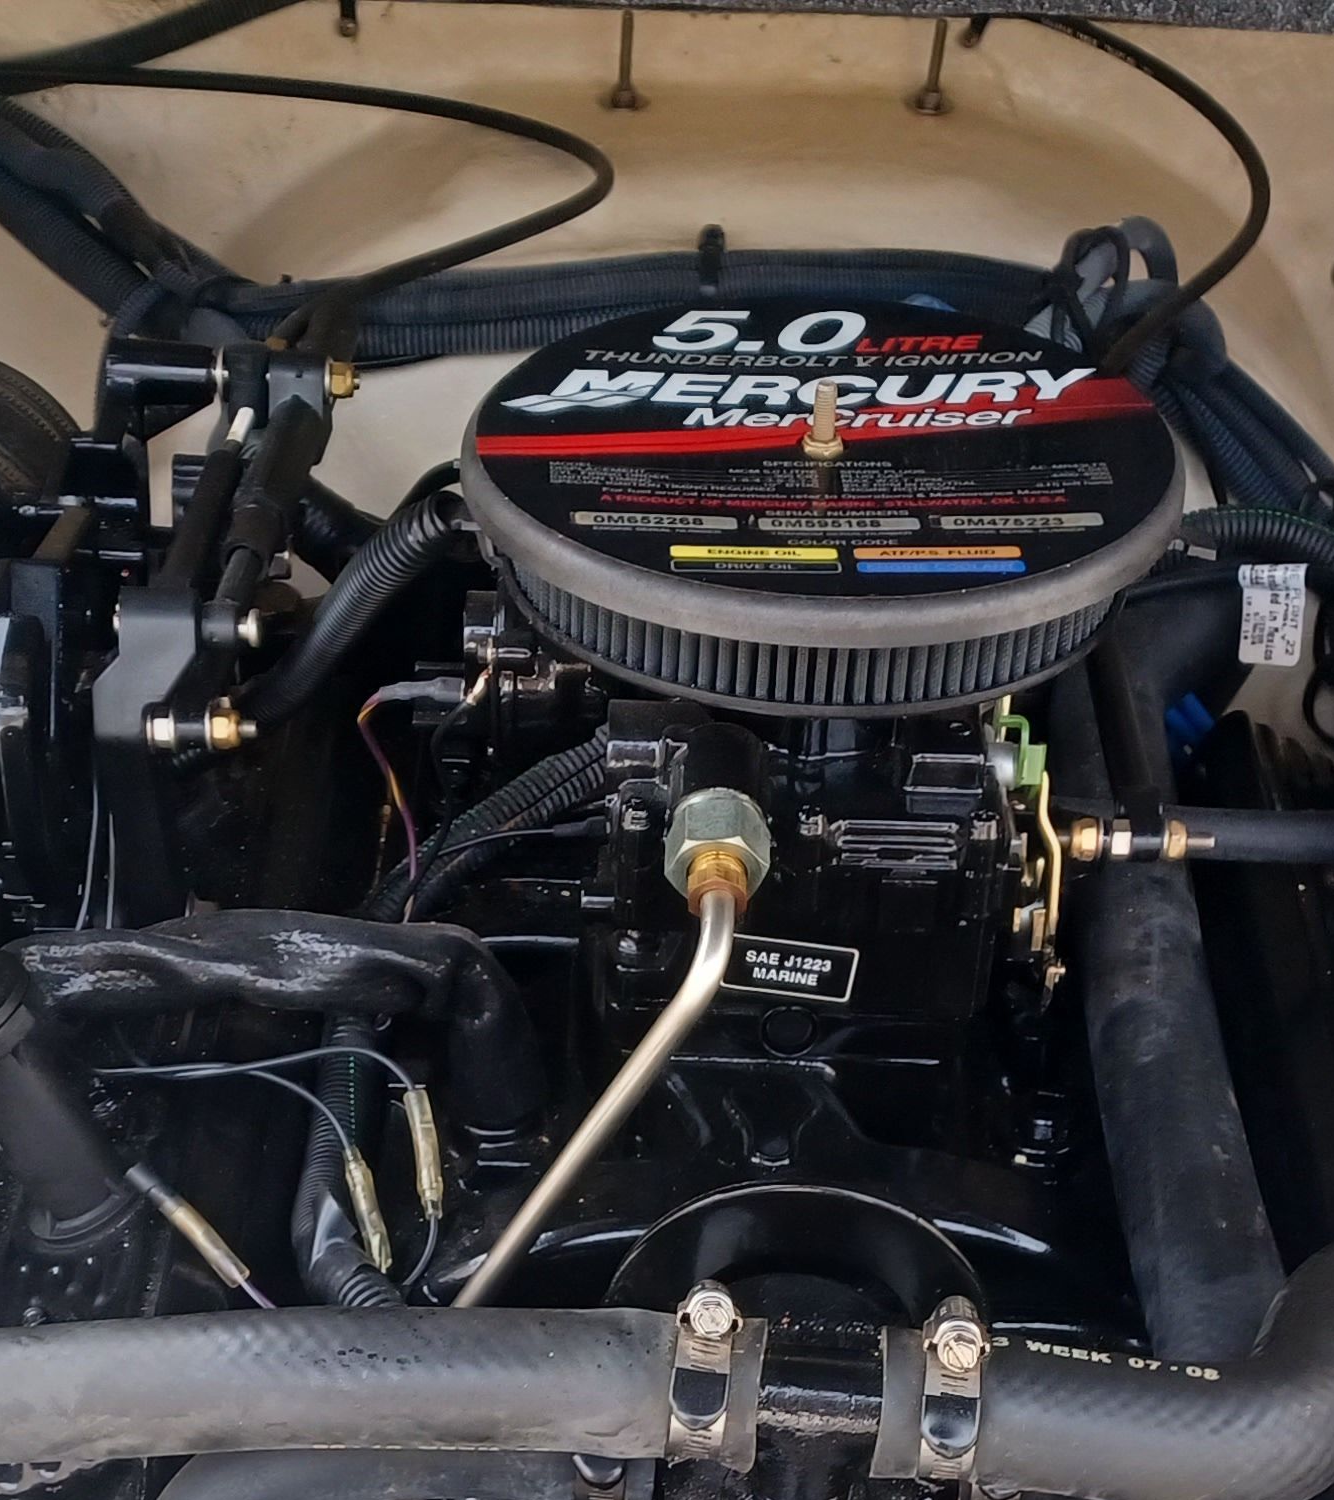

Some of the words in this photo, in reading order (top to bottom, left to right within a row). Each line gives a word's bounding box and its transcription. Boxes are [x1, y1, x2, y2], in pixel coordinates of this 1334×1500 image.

[653, 310, 866, 352] 5.0
[855, 335, 983, 352] LITRE
[585, 349, 849, 367] THUNDERBOLT
[883, 351, 1043, 367] IGNITION
[545, 368, 1097, 407] MERCURY
[682, 407, 1033, 428] MerCruiser
[1284, 640, 1296, 656] 22
[745, 949, 781, 966] SAE
[783, 953, 833, 973] J1223
[752, 966, 819, 987] MARINE
[1025, 1339, 1112, 1365] WEEK
